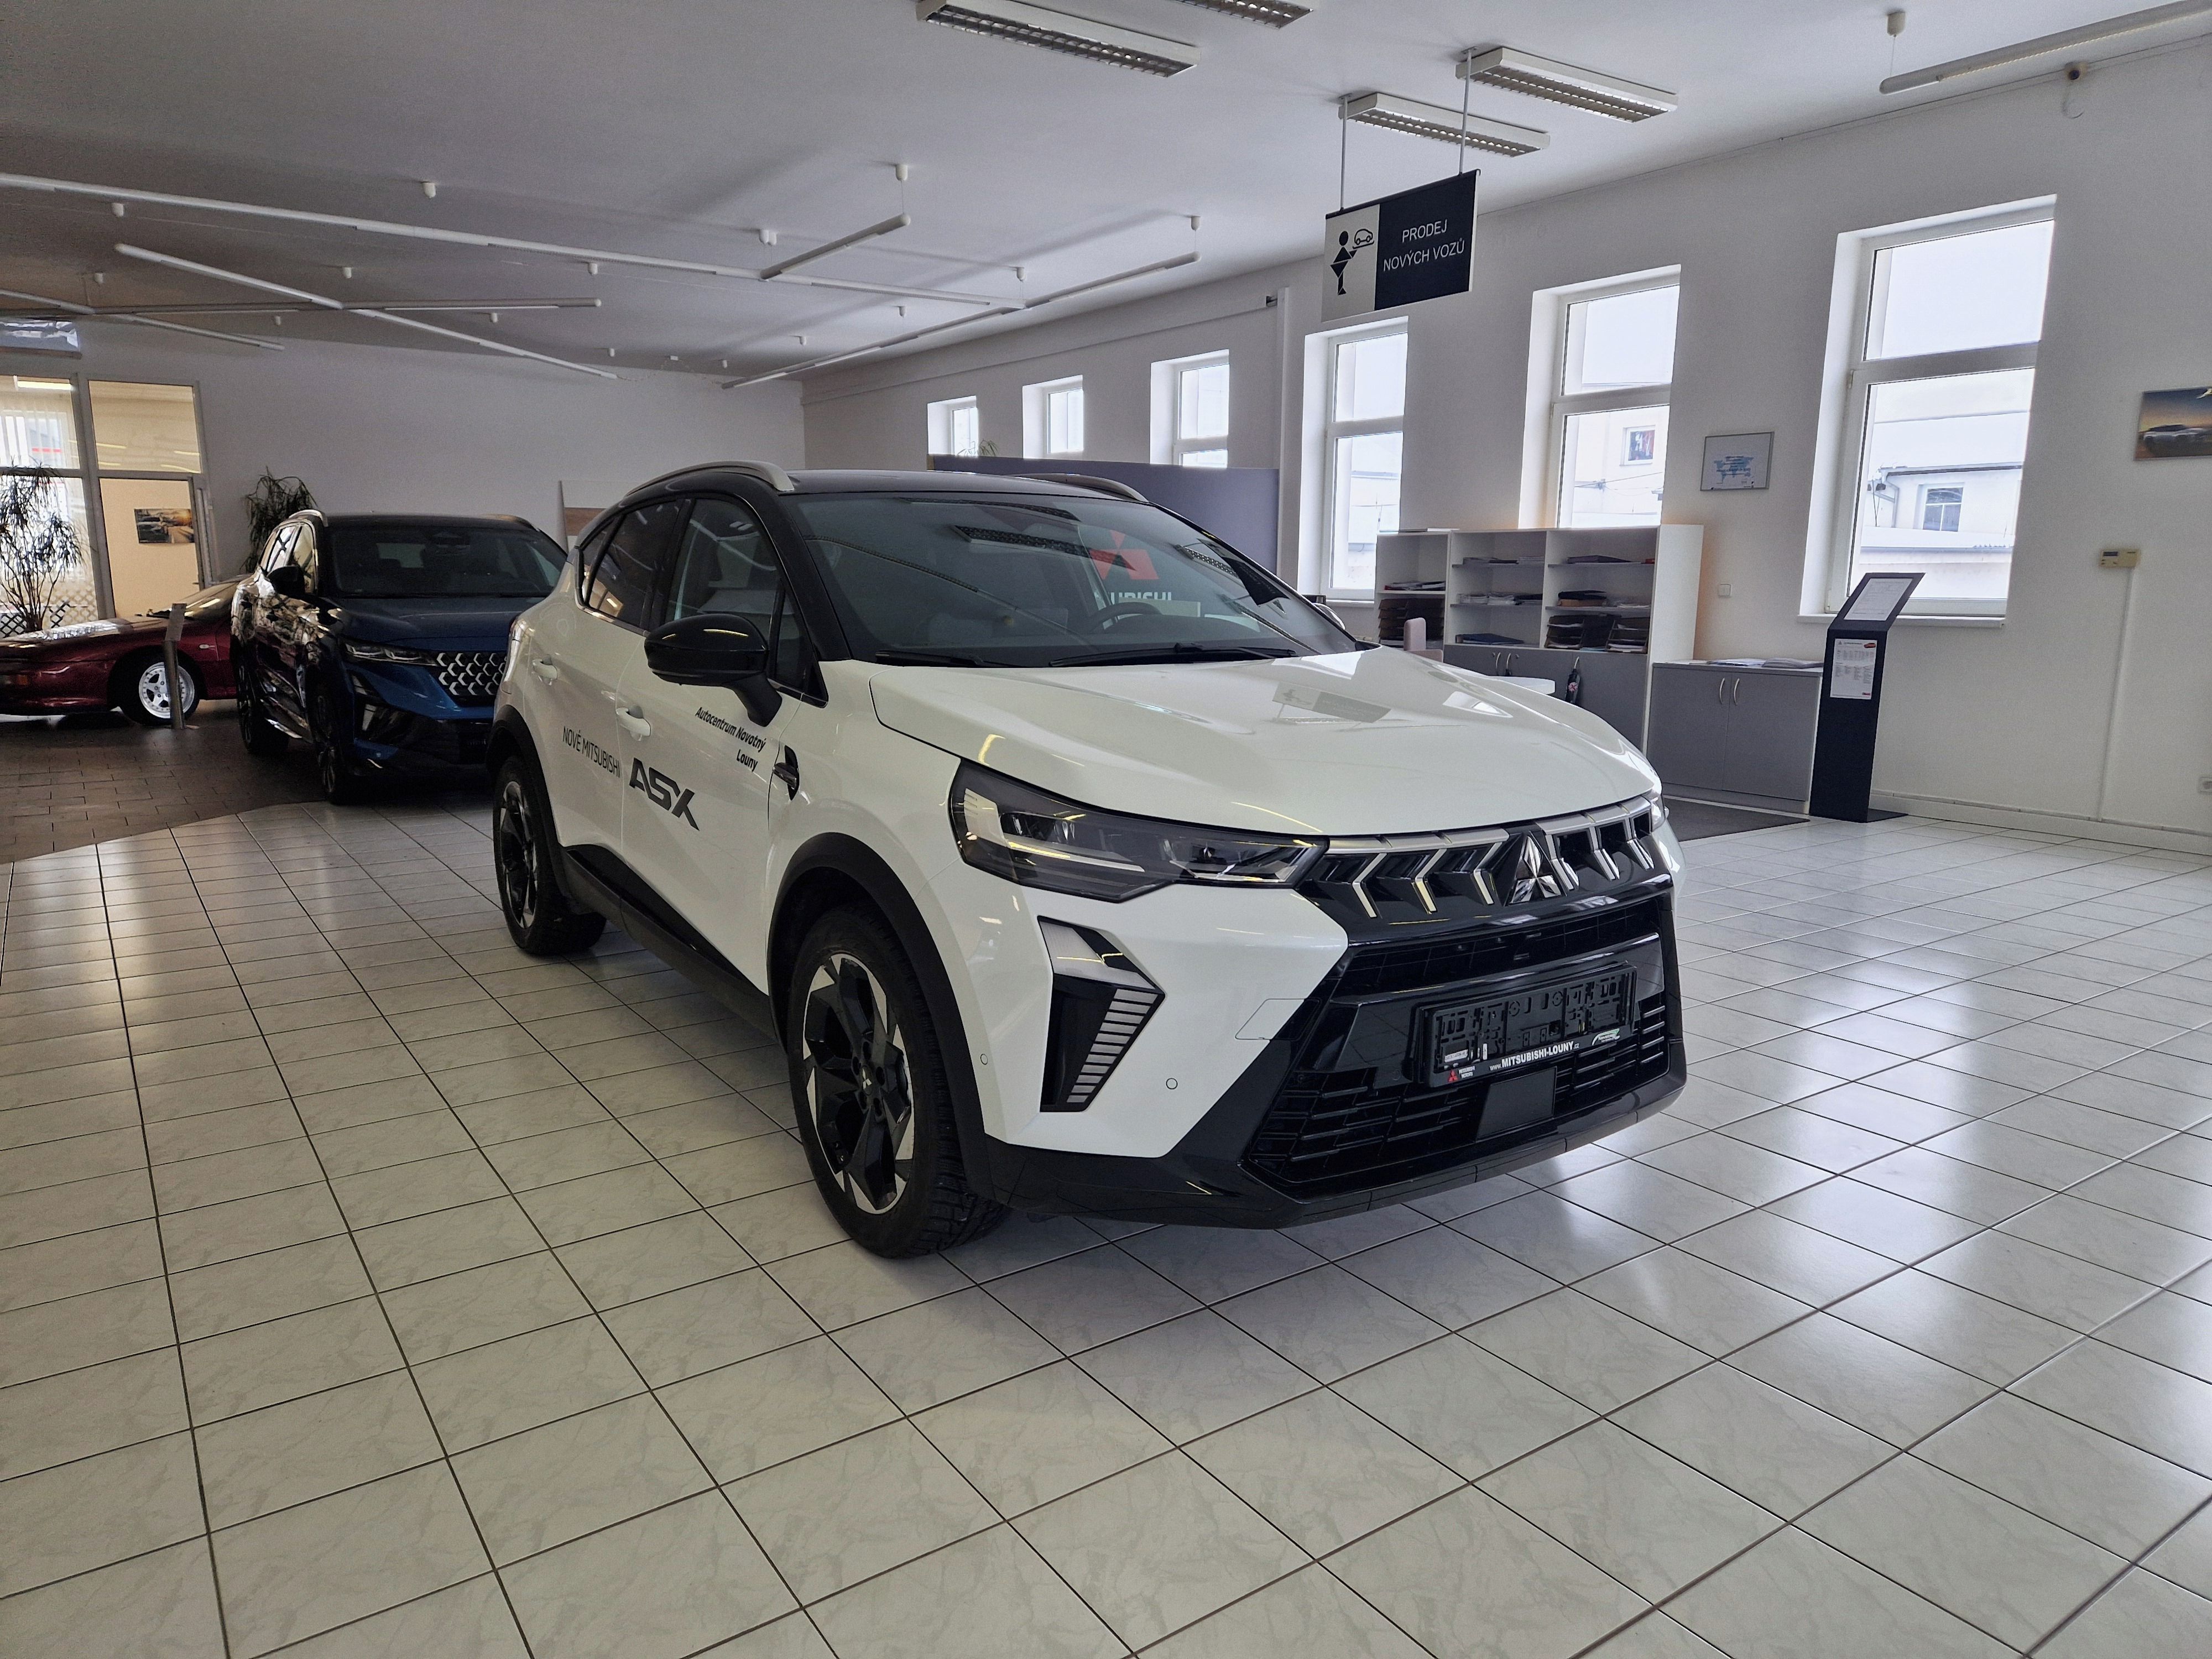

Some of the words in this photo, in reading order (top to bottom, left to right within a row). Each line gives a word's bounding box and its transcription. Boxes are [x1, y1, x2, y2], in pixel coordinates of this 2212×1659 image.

[1401, 219, 1448, 243] PRODEJ
[1383, 248, 1430, 272] NOVÝCH
[1433, 237, 1465, 260] VOZŮ
[695, 707, 737, 736] Autocentrum
[735, 727, 767, 753] Novotný
[736, 749, 758, 772] Louny
[562, 727, 581, 752] NOVÉ
[582, 738, 620, 778] MITSUBISHI
[629, 757, 700, 831] ASX
